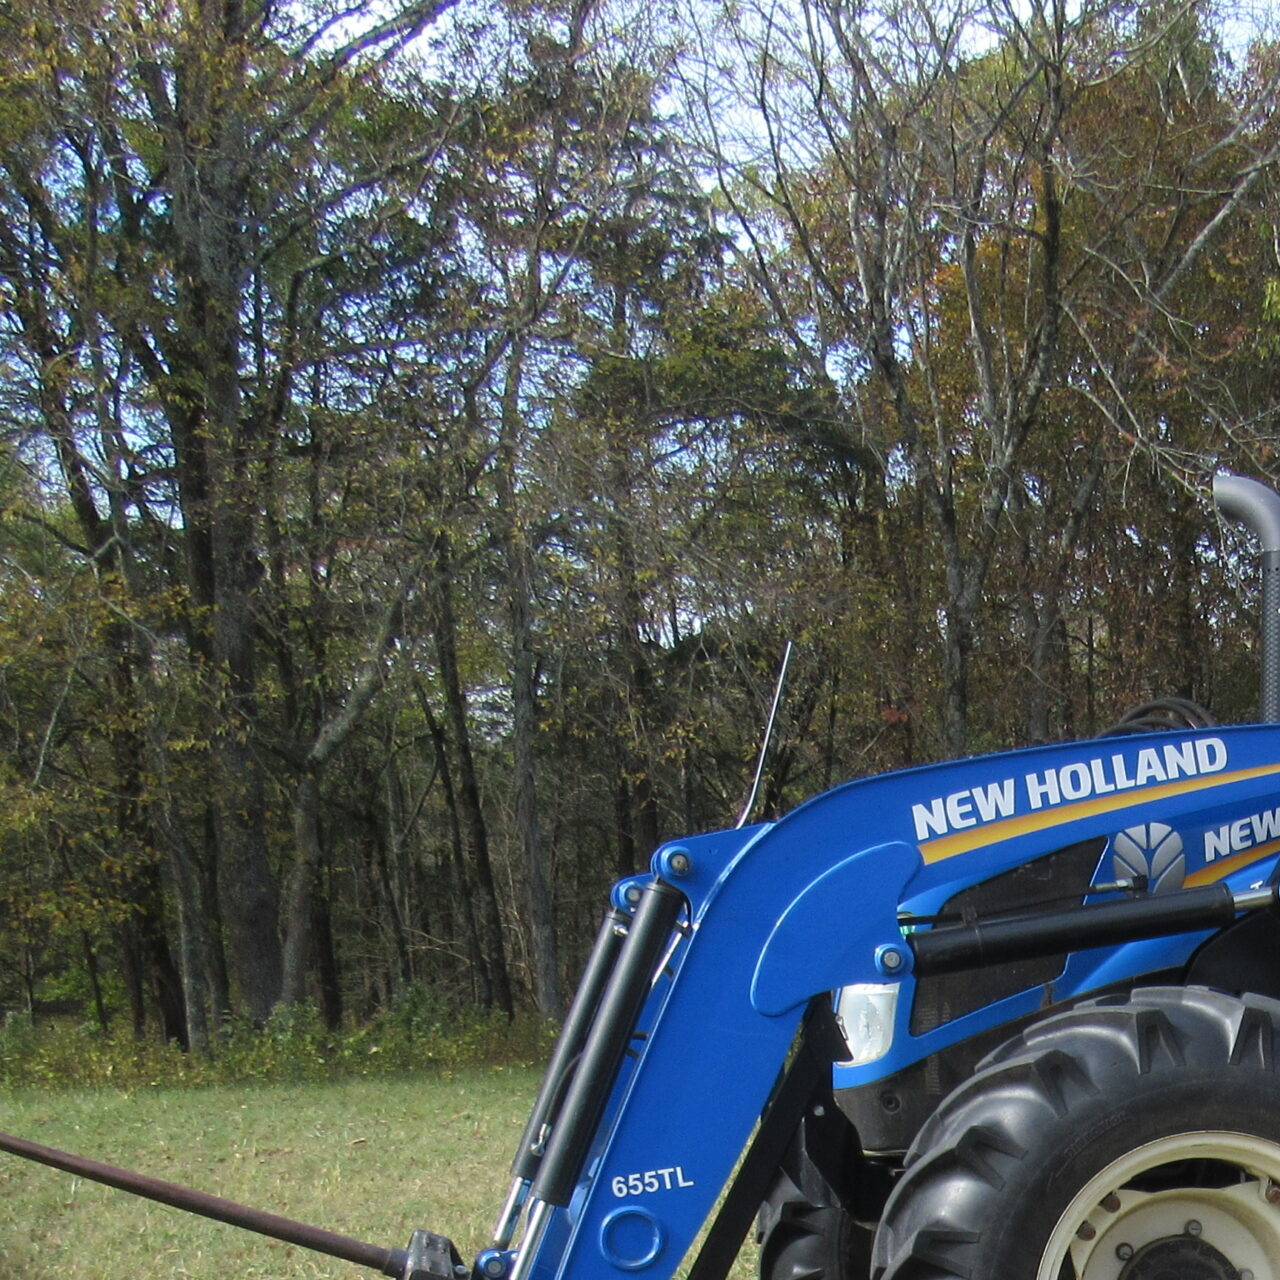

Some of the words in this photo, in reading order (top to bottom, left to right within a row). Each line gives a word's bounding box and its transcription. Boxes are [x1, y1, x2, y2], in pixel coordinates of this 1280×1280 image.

[911, 778, 1015, 841] NEW
[1025, 737, 1228, 810] HOLLAND
[611, 1166, 695, 1198] 655TL
